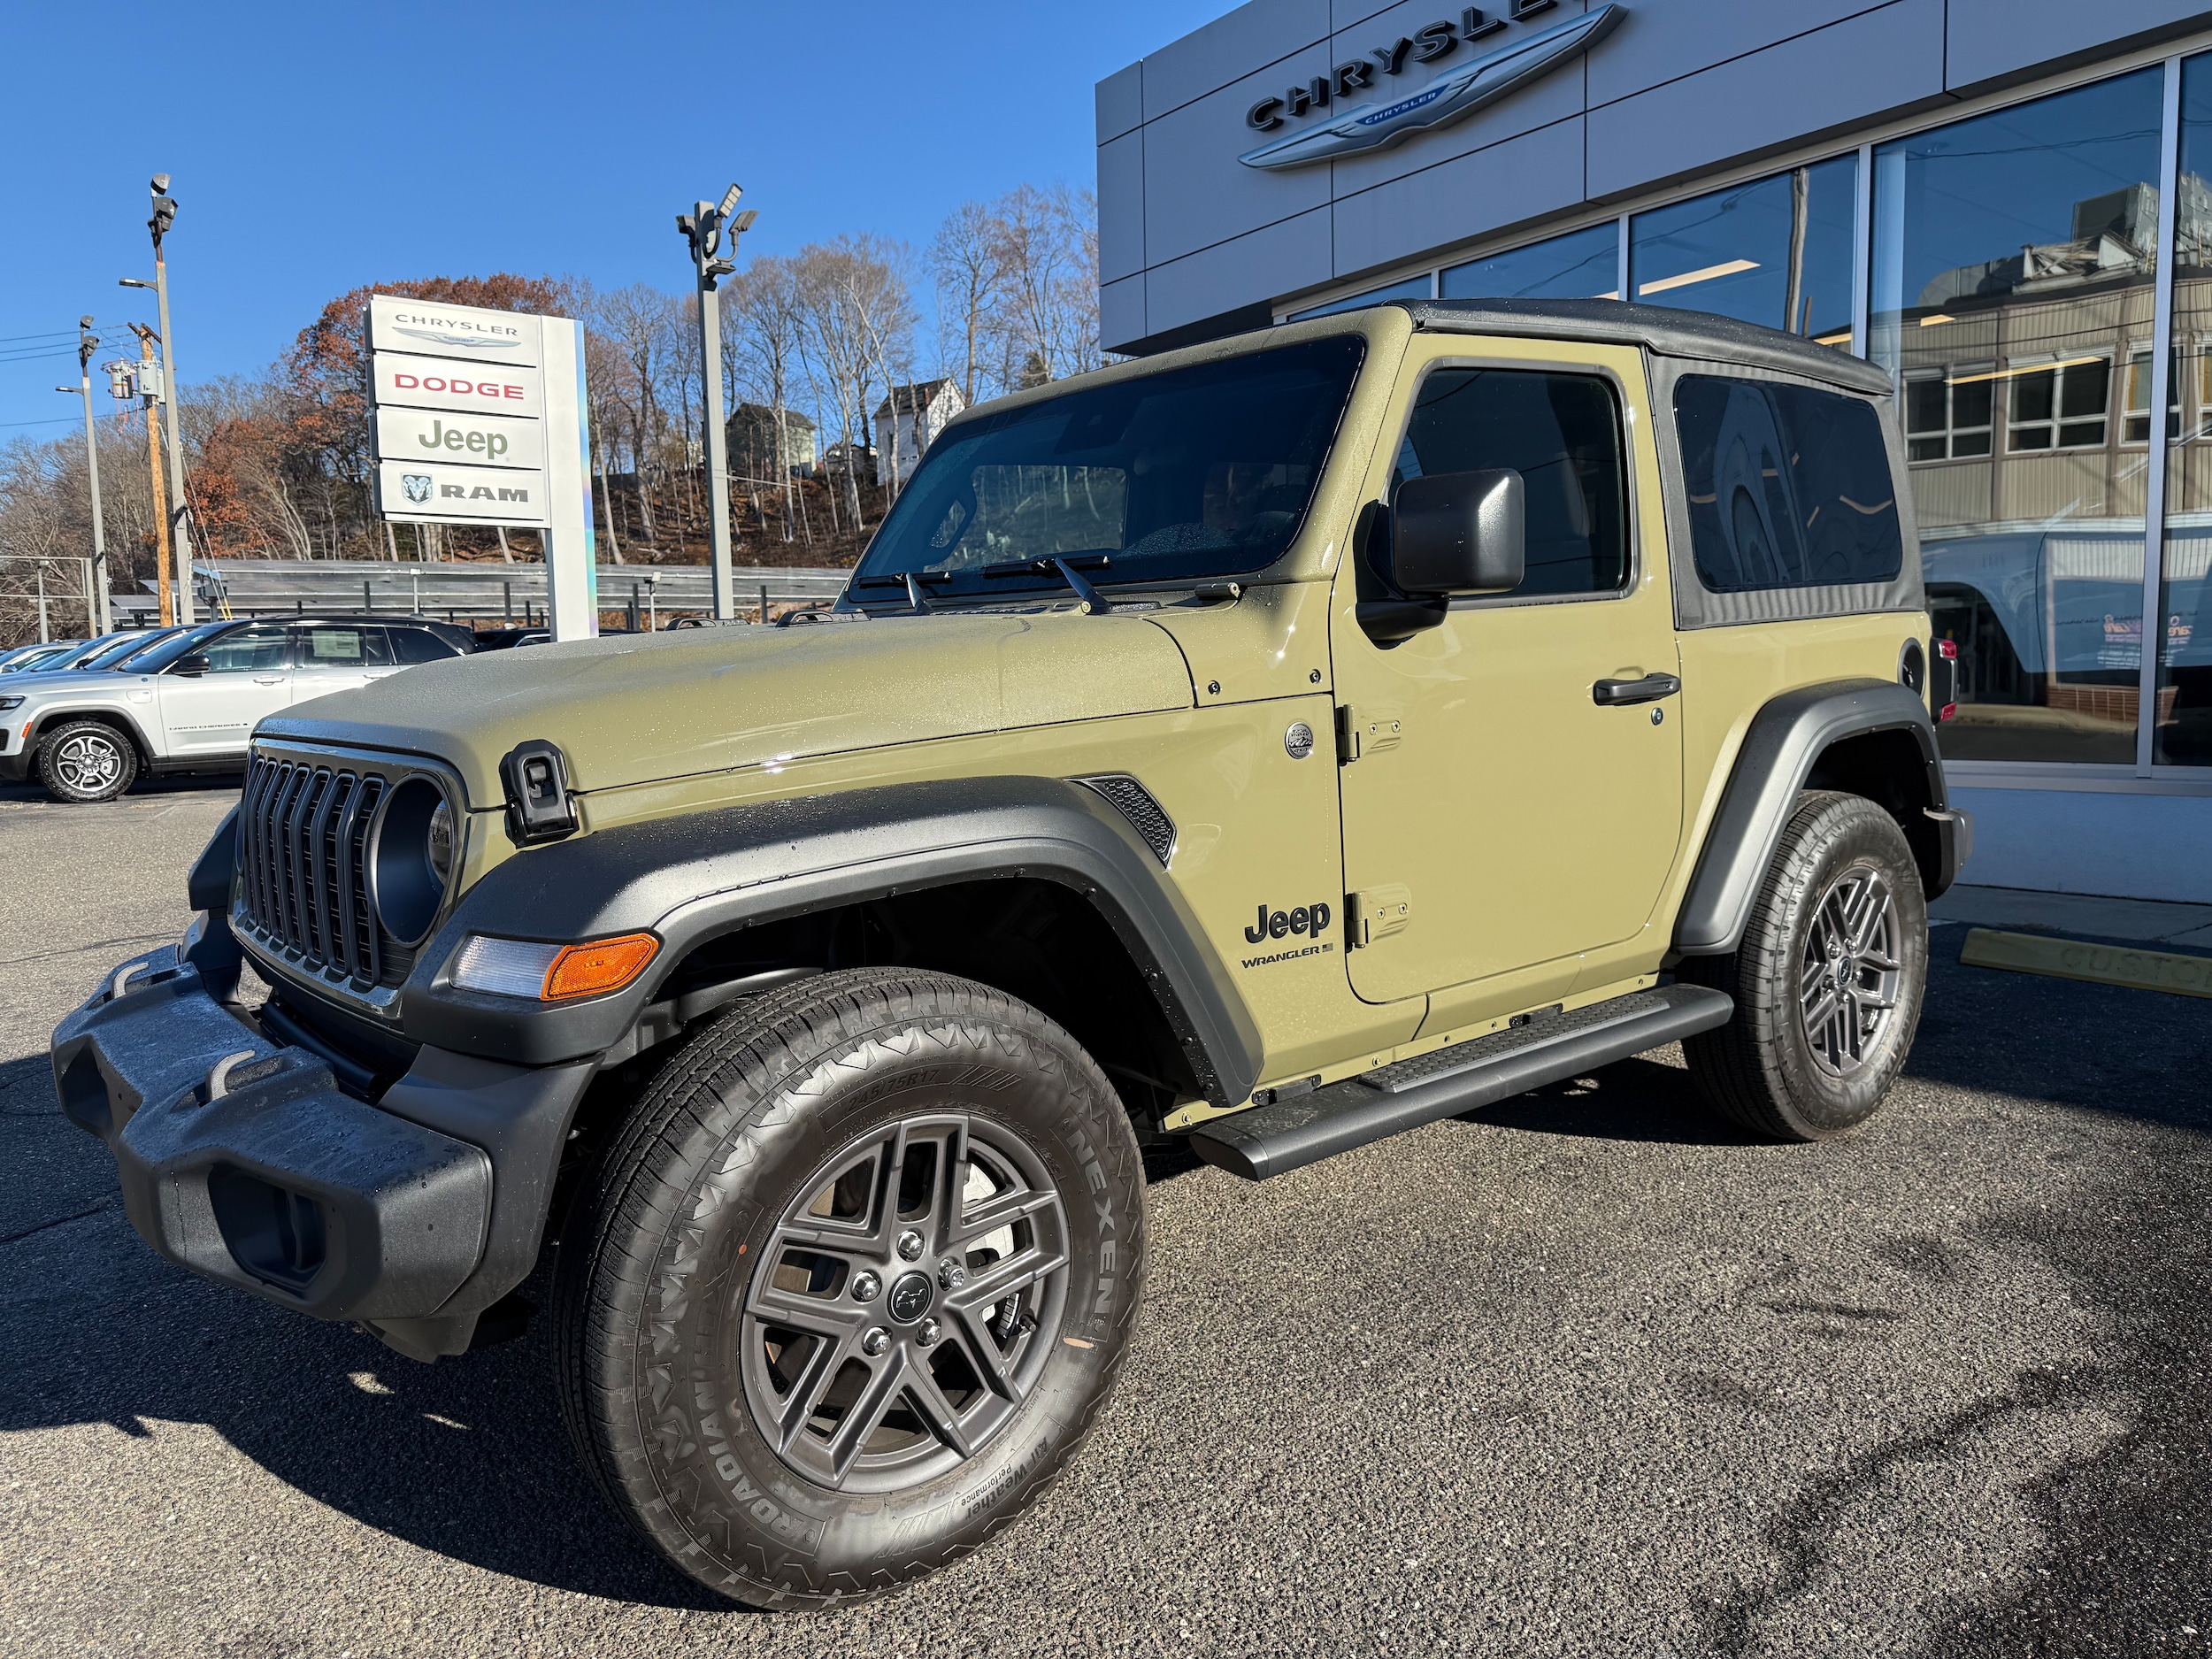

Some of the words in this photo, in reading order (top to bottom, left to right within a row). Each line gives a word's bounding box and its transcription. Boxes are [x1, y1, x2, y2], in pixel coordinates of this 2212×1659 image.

[1365, 92, 1436, 124] CHRYSLER
[395, 314, 518, 337] CHRYSLER
[395, 373, 524, 400] DODGE
[419, 420, 508, 459] Jeep
[441, 484, 528, 503] RAM
[1244, 902, 1331, 944] Jeep
[1241, 946, 1320, 969] WRANGLER
[848, 1069, 941, 1111] 245/75R17
[1065, 1130, 1117, 1313] NEXEN
[694, 1380, 803, 1538] ROADIAN
[964, 1436, 1048, 1520] All-Weather
[960, 1463, 1012, 1508] Performance
